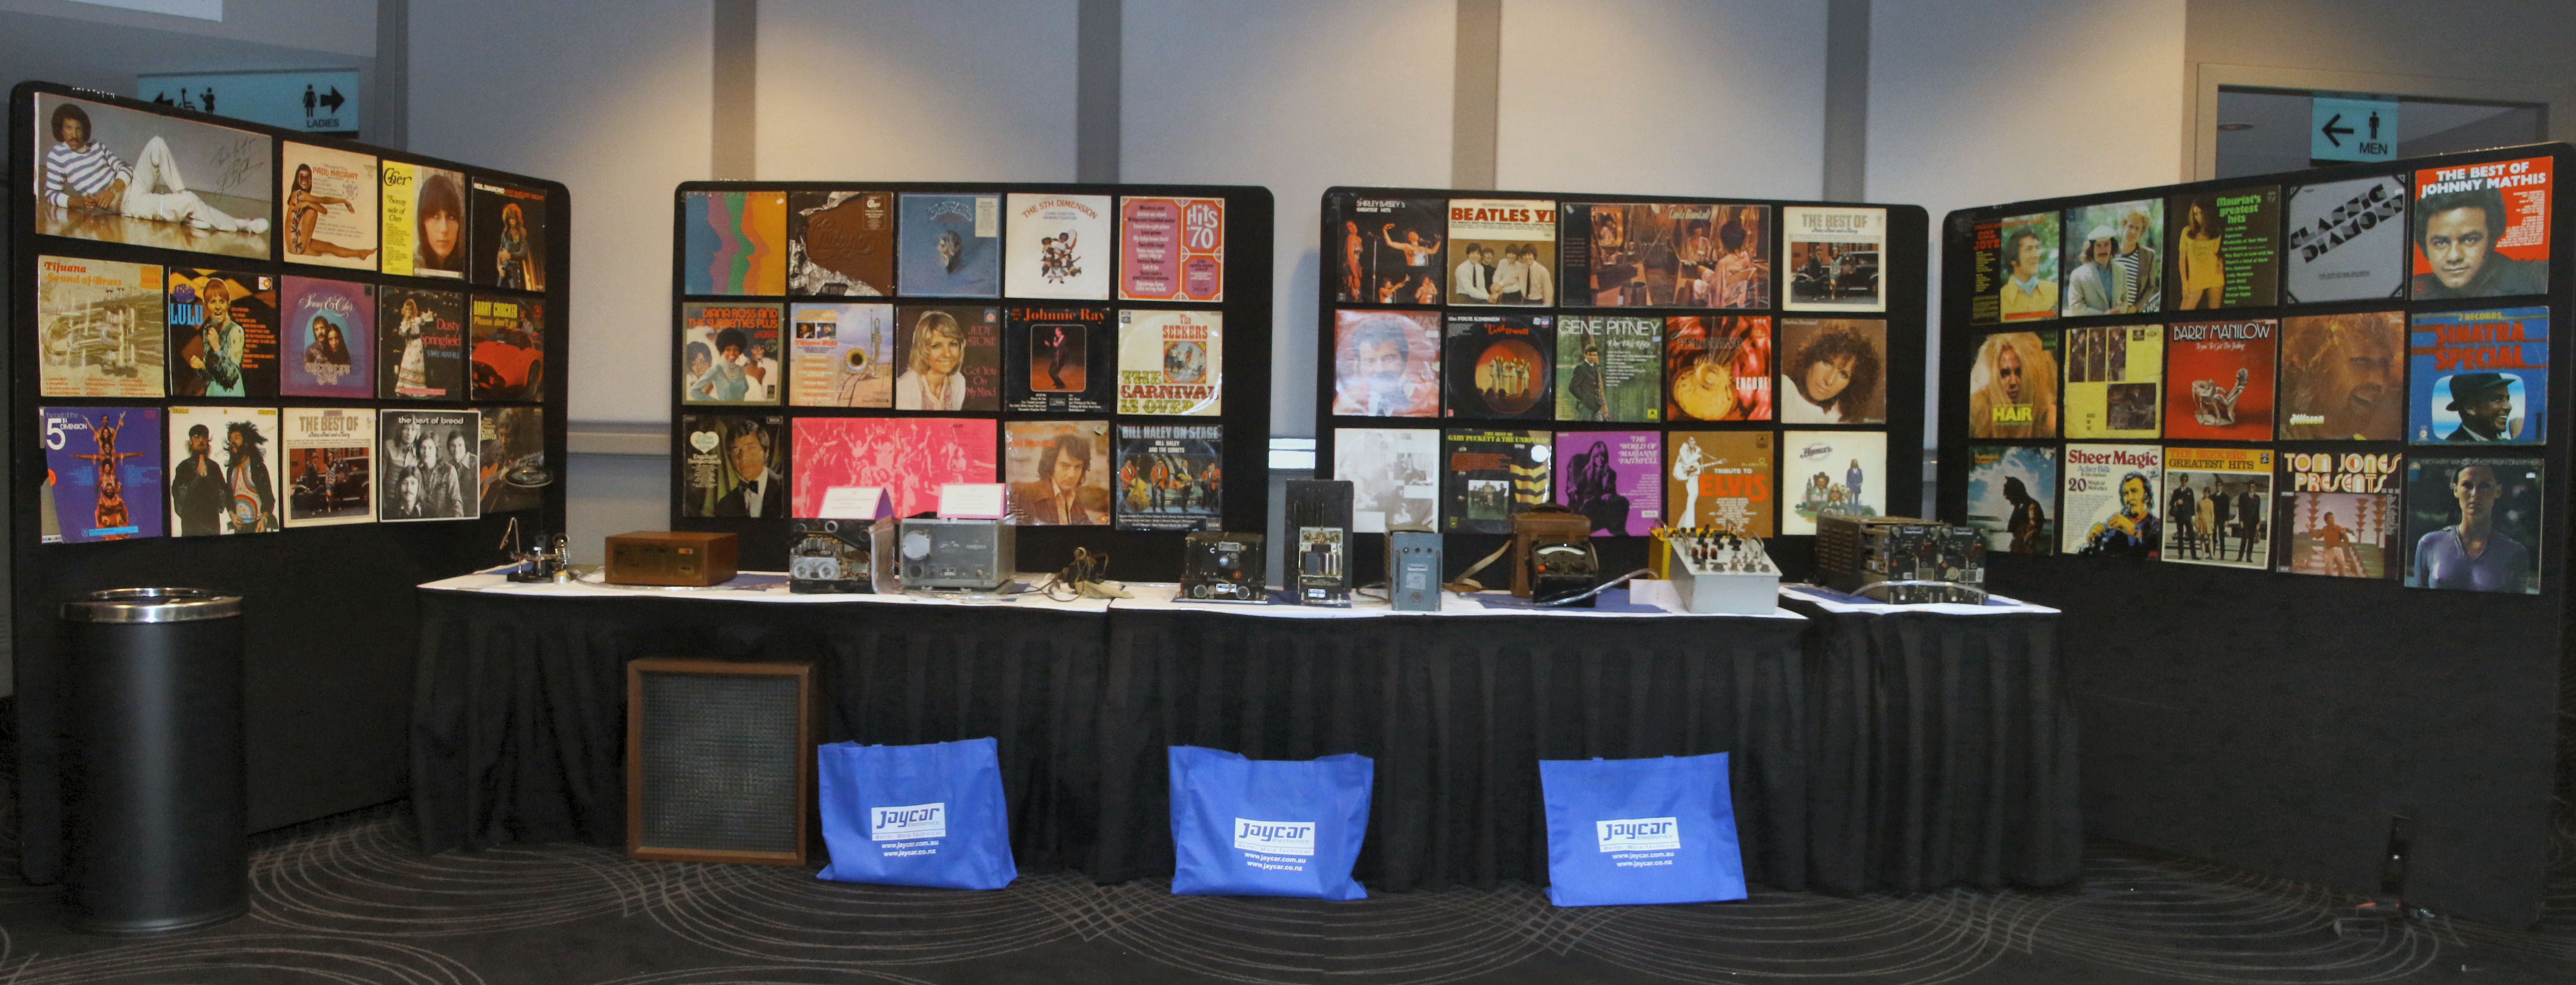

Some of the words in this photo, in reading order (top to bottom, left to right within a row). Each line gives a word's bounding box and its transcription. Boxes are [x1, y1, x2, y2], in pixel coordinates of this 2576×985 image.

[307, 119, 339, 128] LADIES
[2360, 142, 2387, 155] MEN
[384, 168, 412, 187] Cher
[2436, 169, 2465, 181] THE
[2470, 164, 2506, 178] BEST
[2510, 161, 2529, 173] OF
[2421, 179, 2482, 199] JOHNNY
[2487, 173, 2546, 189] MATHIS
[1022, 205, 1038, 218] THE
[1039, 200, 1054, 210] 5TH
[1057, 200, 1098, 219] DIMENSION
[1451, 207, 1530, 222] BEATLES
[1535, 210, 1556, 223] VI
[2219, 204, 2258, 217] greatest
[2290, 184, 2387, 249] CLASSIC
[1802, 214, 1823, 228] THE
[1825, 215, 1851, 228] BEST
[1854, 215, 1868, 228] OF
[44, 262, 87, 273] Tijuana
[81, 276, 92, 286] of
[170, 304, 203, 325] LULU
[474, 301, 492, 316] BARRY
[493, 302, 518, 319] CROCKER
[702, 308, 731, 318] DIANA
[733, 308, 756, 318] ROSS
[758, 308, 778, 318] AND
[1023, 308, 1076, 321] Johnnie
[1080, 308, 1105, 324] Ray
[2465, 312, 2503, 321] RECORDS
[437, 318, 460, 332] Dusty
[688, 319, 707, 327] THE
[708, 319, 755, 328] SUPREMES
[757, 319, 778, 327] PLUS
[1180, 314, 1191, 325] The
[968, 326, 991, 335] JUDY
[1163, 325, 1208, 339] SEEKERS
[1558, 319, 1601, 335] GENE
[1607, 320, 1661, 336] PITNEY
[2173, 325, 2207, 340] BARRY
[2210, 323, 2271, 340] MANILOW
[2435, 322, 2525, 344] SINATRA
[420, 334, 461, 349] Springfield
[966, 337, 996, 347] STONE
[2435, 344, 2525, 372] SPECIAL
[964, 366, 981, 375] Got
[982, 366, 997, 375] You
[1121, 371, 1162, 384] THE
[973, 377, 987, 385] On
[966, 386, 977, 399] My
[977, 386, 997, 397] Mind
[1121, 385, 1219, 400] CARNIVAL
[1120, 399, 1138, 413] IS
[1143, 399, 1194, 414] OVER
[1993, 406, 2033, 422] HAIR
[299, 416, 318, 431] THE
[321, 416, 342, 431] BEST
[343, 416, 359, 431] OF
[46, 418, 67, 450] 5
[1122, 425, 1141, 439] BILL
[1144, 426, 1172, 439] HALEY
[1173, 426, 1187, 439] ON
[1189, 426, 1218, 439] STAGE
[2068, 449, 2110, 466] Sheer
[2113, 450, 2158, 468] Magic
[2169, 449, 2192, 459] THE
[2194, 449, 2248, 460] SEEKERS
[2169, 458, 2225, 468] GREATEST
[2229, 460, 2254, 469] HITS
[2284, 453, 2332, 473] TOM
[2338, 453, 2402, 474] JONES
[1699, 475, 1769, 502] ELVIS
[2068, 478, 2086, 491] 20
[2295, 472, 2388, 494] PRESENTS
[881, 840, 939, 849] www.jaycar.com.au
[1244, 852, 1306, 863] www.jaycar.com.au
[1247, 861, 1303, 871] www.jaycar.co.nz
